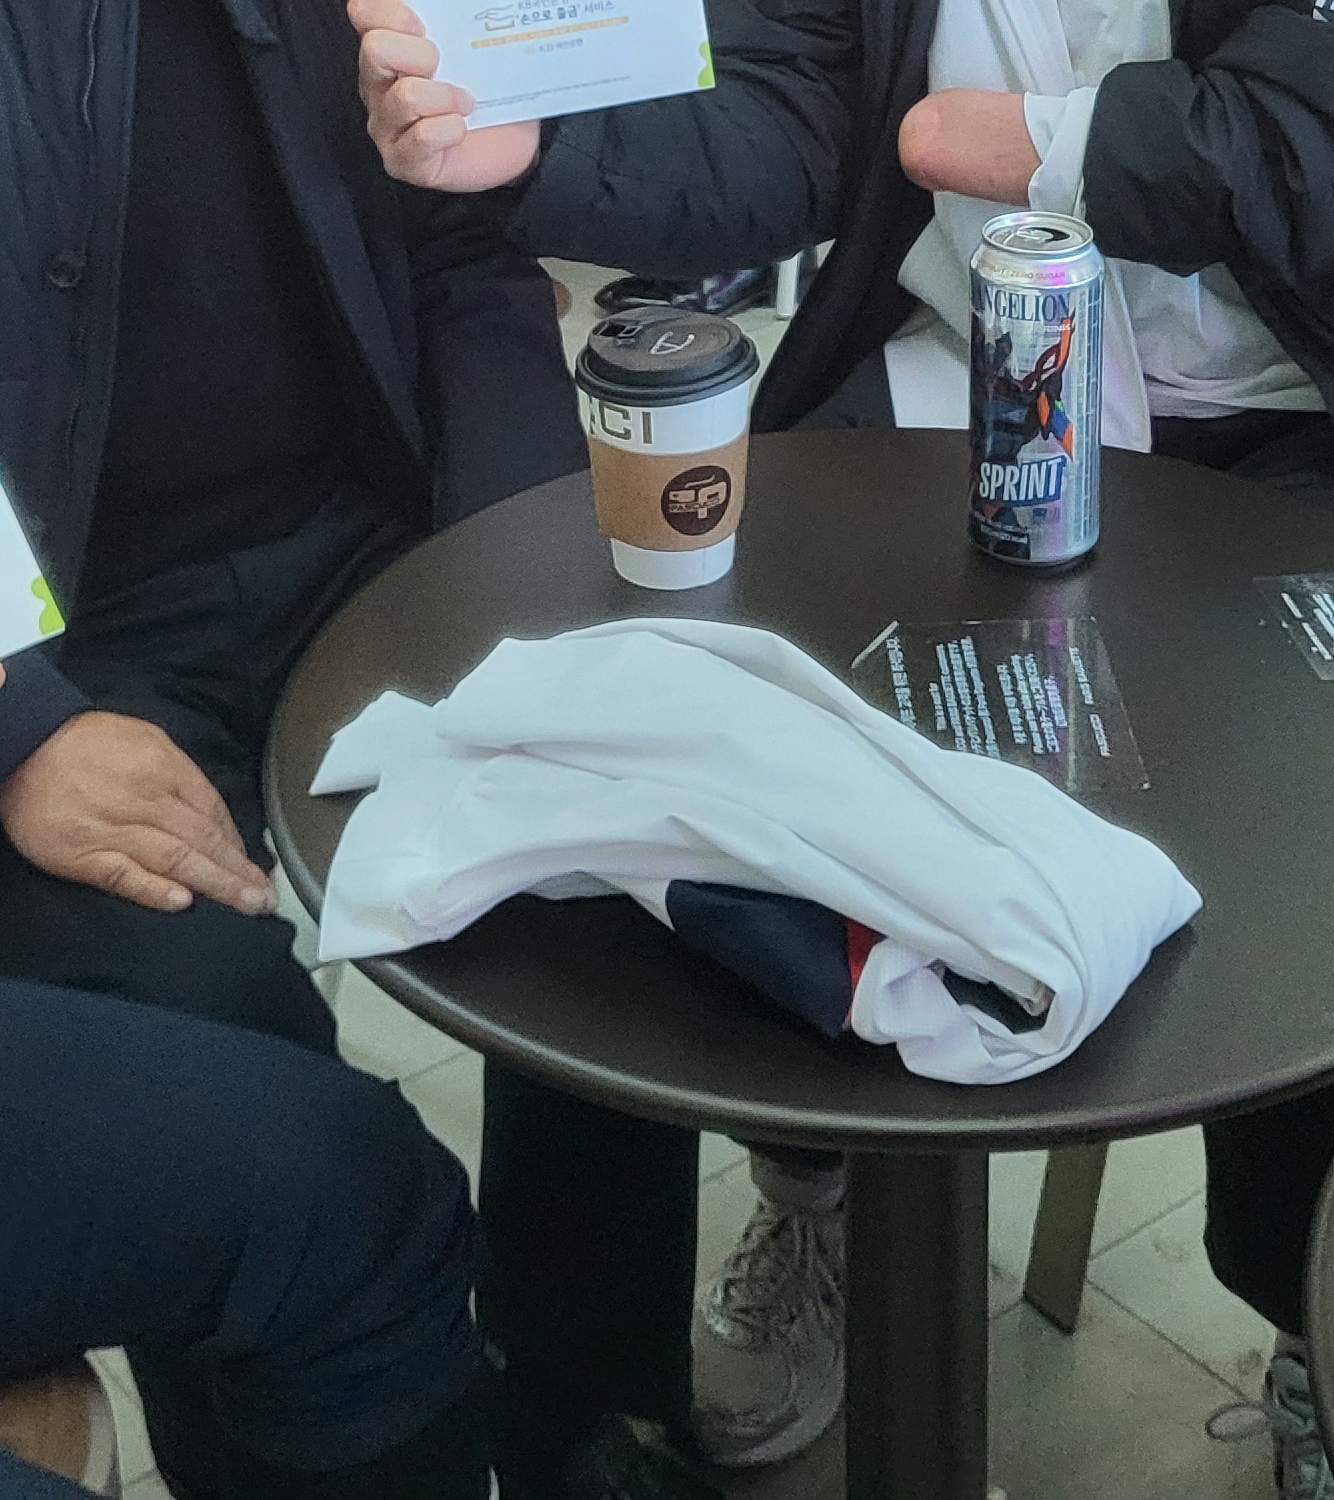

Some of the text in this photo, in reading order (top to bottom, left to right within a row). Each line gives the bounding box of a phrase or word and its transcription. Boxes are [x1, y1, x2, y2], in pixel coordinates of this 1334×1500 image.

[584, 0, 615, 14] 서비스
[1010, 269, 1034, 279] ZERO
[1035, 271, 1066, 280] SUGAR
[979, 284, 1072, 323] NGELION
[979, 457, 1064, 501] SPRINT
